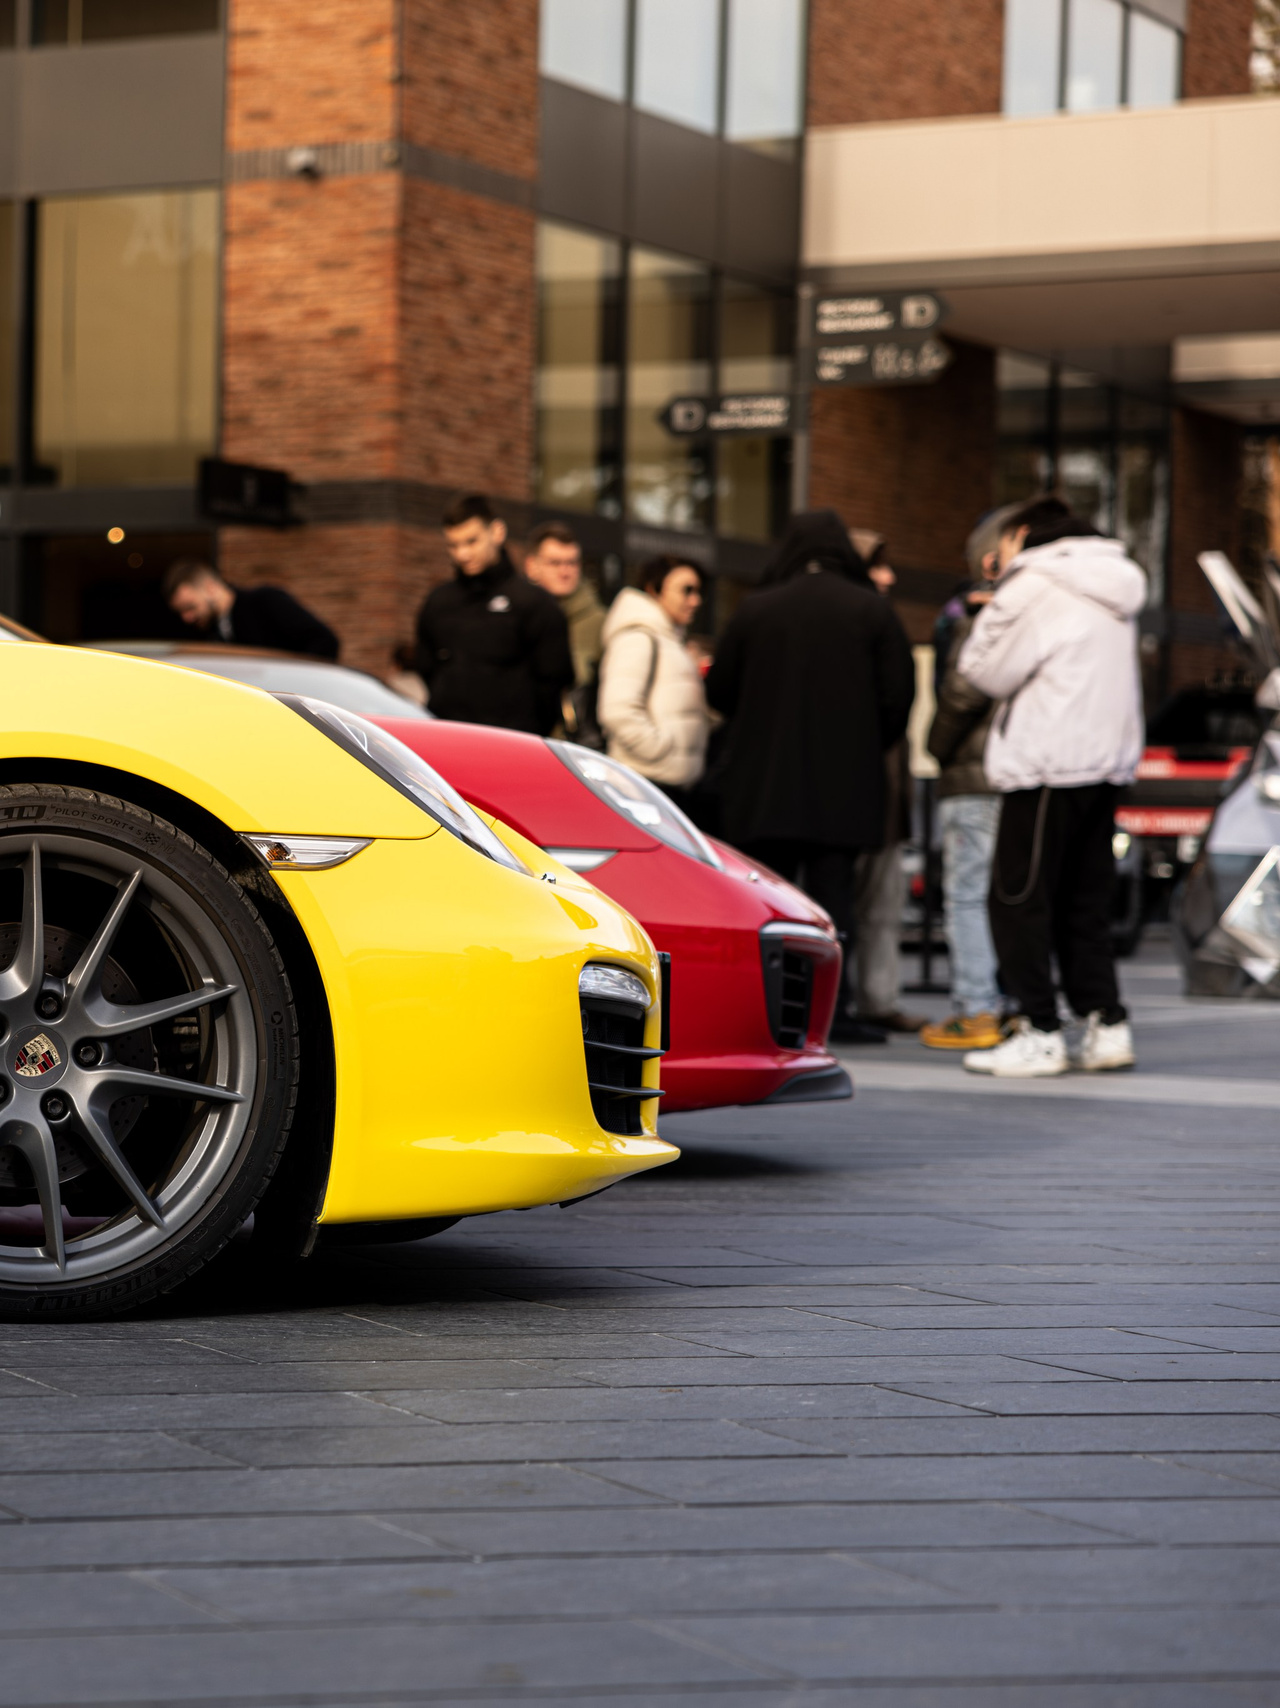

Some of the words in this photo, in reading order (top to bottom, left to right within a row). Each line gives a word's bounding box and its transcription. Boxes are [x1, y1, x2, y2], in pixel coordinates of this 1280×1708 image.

[55, 807, 88, 818] PILOT
[91, 813, 129, 830] SPORT
[39, 1034, 59, 1064] PORSCHE
[277, 1027, 285, 1065] MICHELIN
[41, 1268, 158, 1310] MICHELIN
